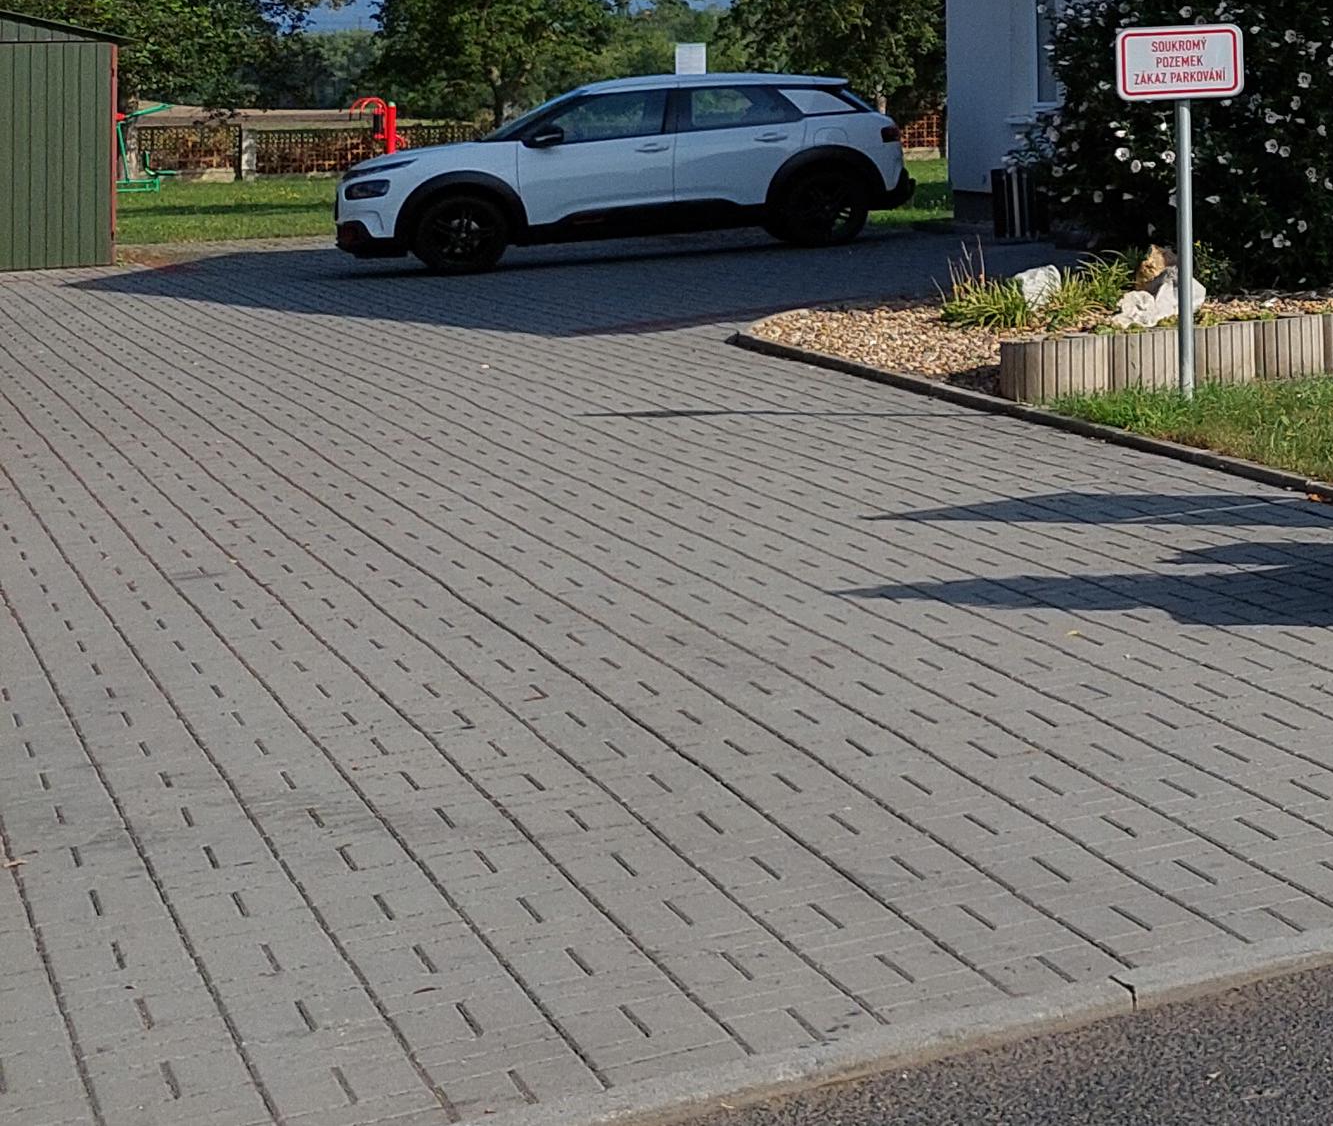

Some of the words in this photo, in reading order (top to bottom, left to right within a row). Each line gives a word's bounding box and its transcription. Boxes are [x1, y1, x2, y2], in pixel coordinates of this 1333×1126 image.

[1151, 36, 1207, 52] SOUKROMÝ
[1156, 55, 1204, 68] POZEMEK
[1134, 70, 1167, 85] ZÁKAZ
[1170, 67, 1226, 83] PARKOVÁNÍ
